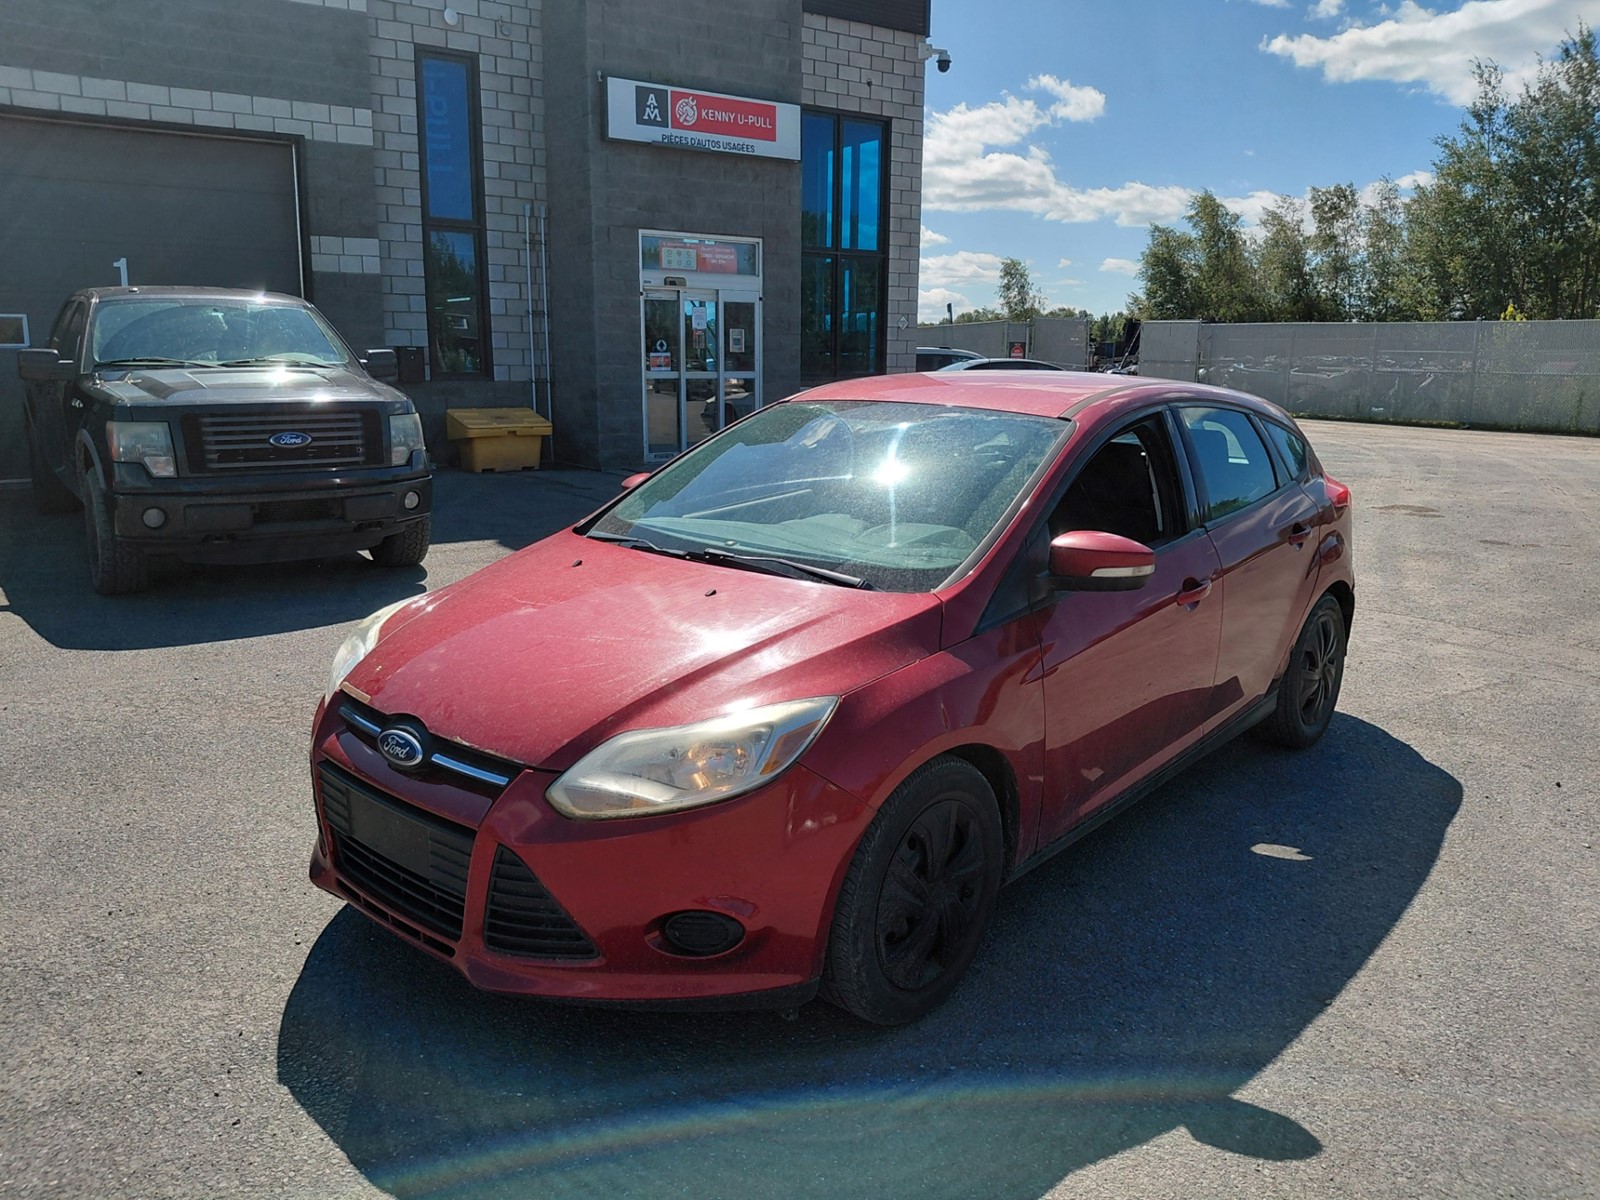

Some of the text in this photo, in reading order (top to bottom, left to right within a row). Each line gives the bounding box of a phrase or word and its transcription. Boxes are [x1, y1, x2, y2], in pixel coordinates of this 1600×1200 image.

[701, 108, 773, 129] KENNY U-PULL
[661, 132, 756, 153] PIÈCES D'AUTOS USAGÉES
[279, 434, 303, 445] Ford
[383, 734, 410, 759] Ford
